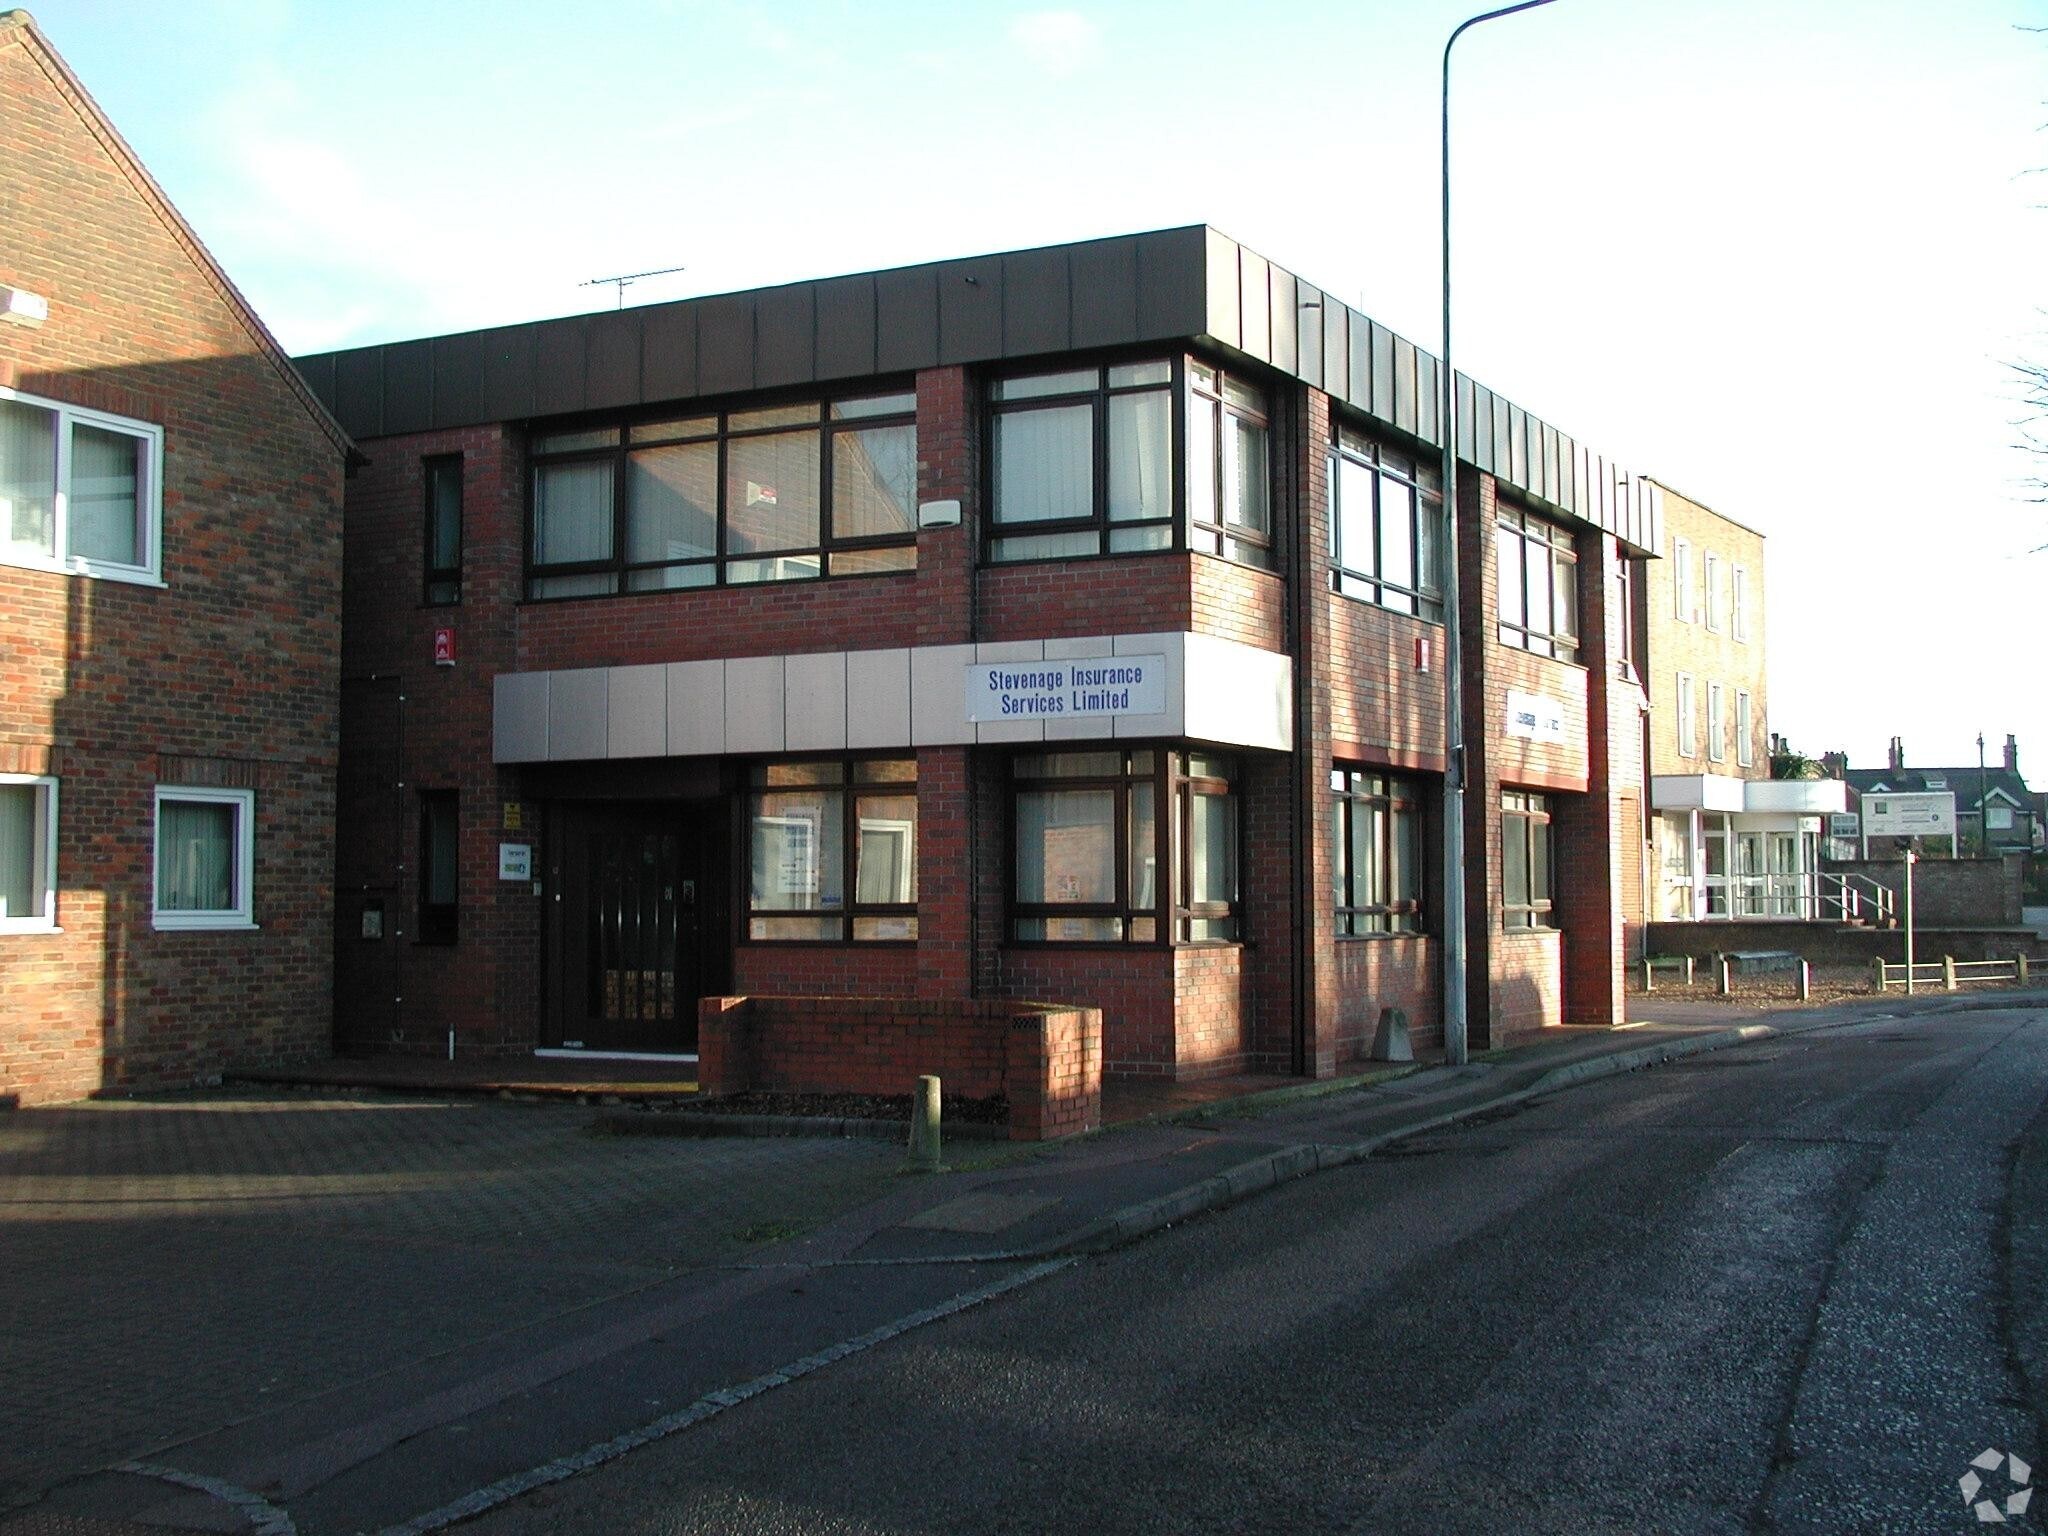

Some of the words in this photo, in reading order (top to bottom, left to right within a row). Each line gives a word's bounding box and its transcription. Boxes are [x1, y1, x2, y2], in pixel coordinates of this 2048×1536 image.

[989, 670, 1063, 691] Stevenage
[1071, 666, 1142, 686] Insurance
[1001, 693, 1064, 714] Services
[1073, 689, 1129, 711] Limited
